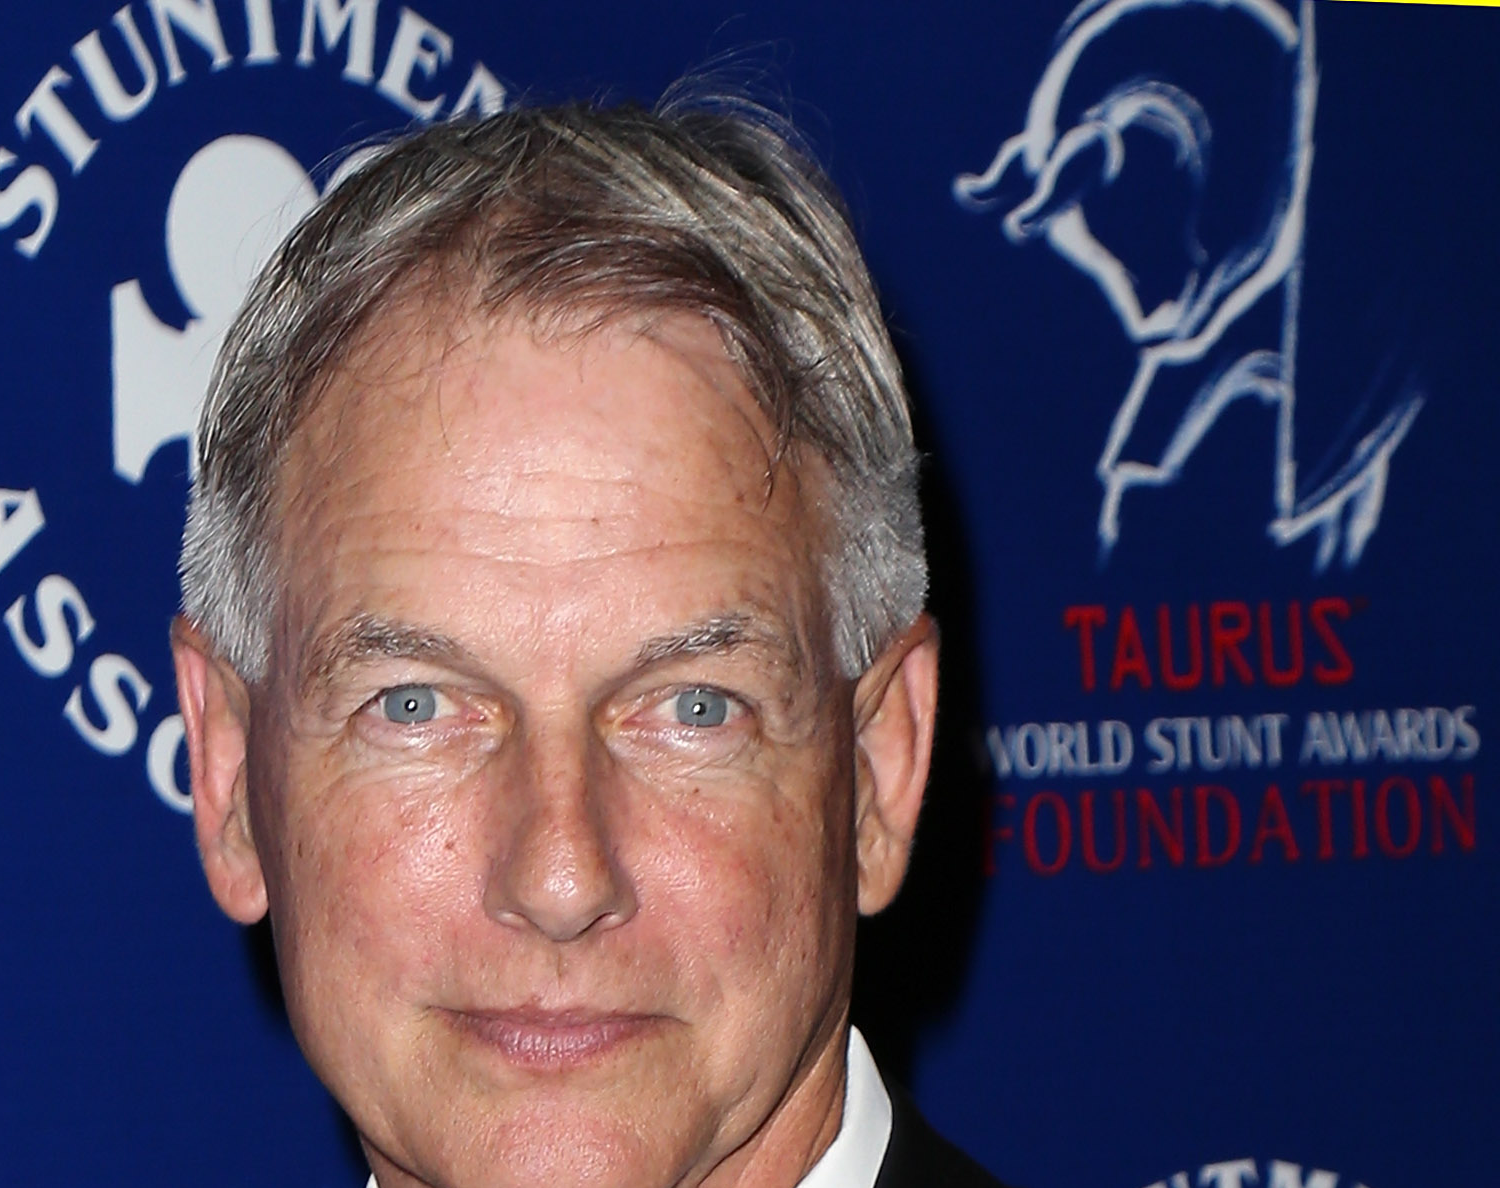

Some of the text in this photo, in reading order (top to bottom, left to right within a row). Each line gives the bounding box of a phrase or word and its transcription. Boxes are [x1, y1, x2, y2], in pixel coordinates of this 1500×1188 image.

[1063, 597, 1355, 691] TAURUS
[1145, 713, 1289, 771] STUNT
[1302, 705, 1481, 766] AWARDS
